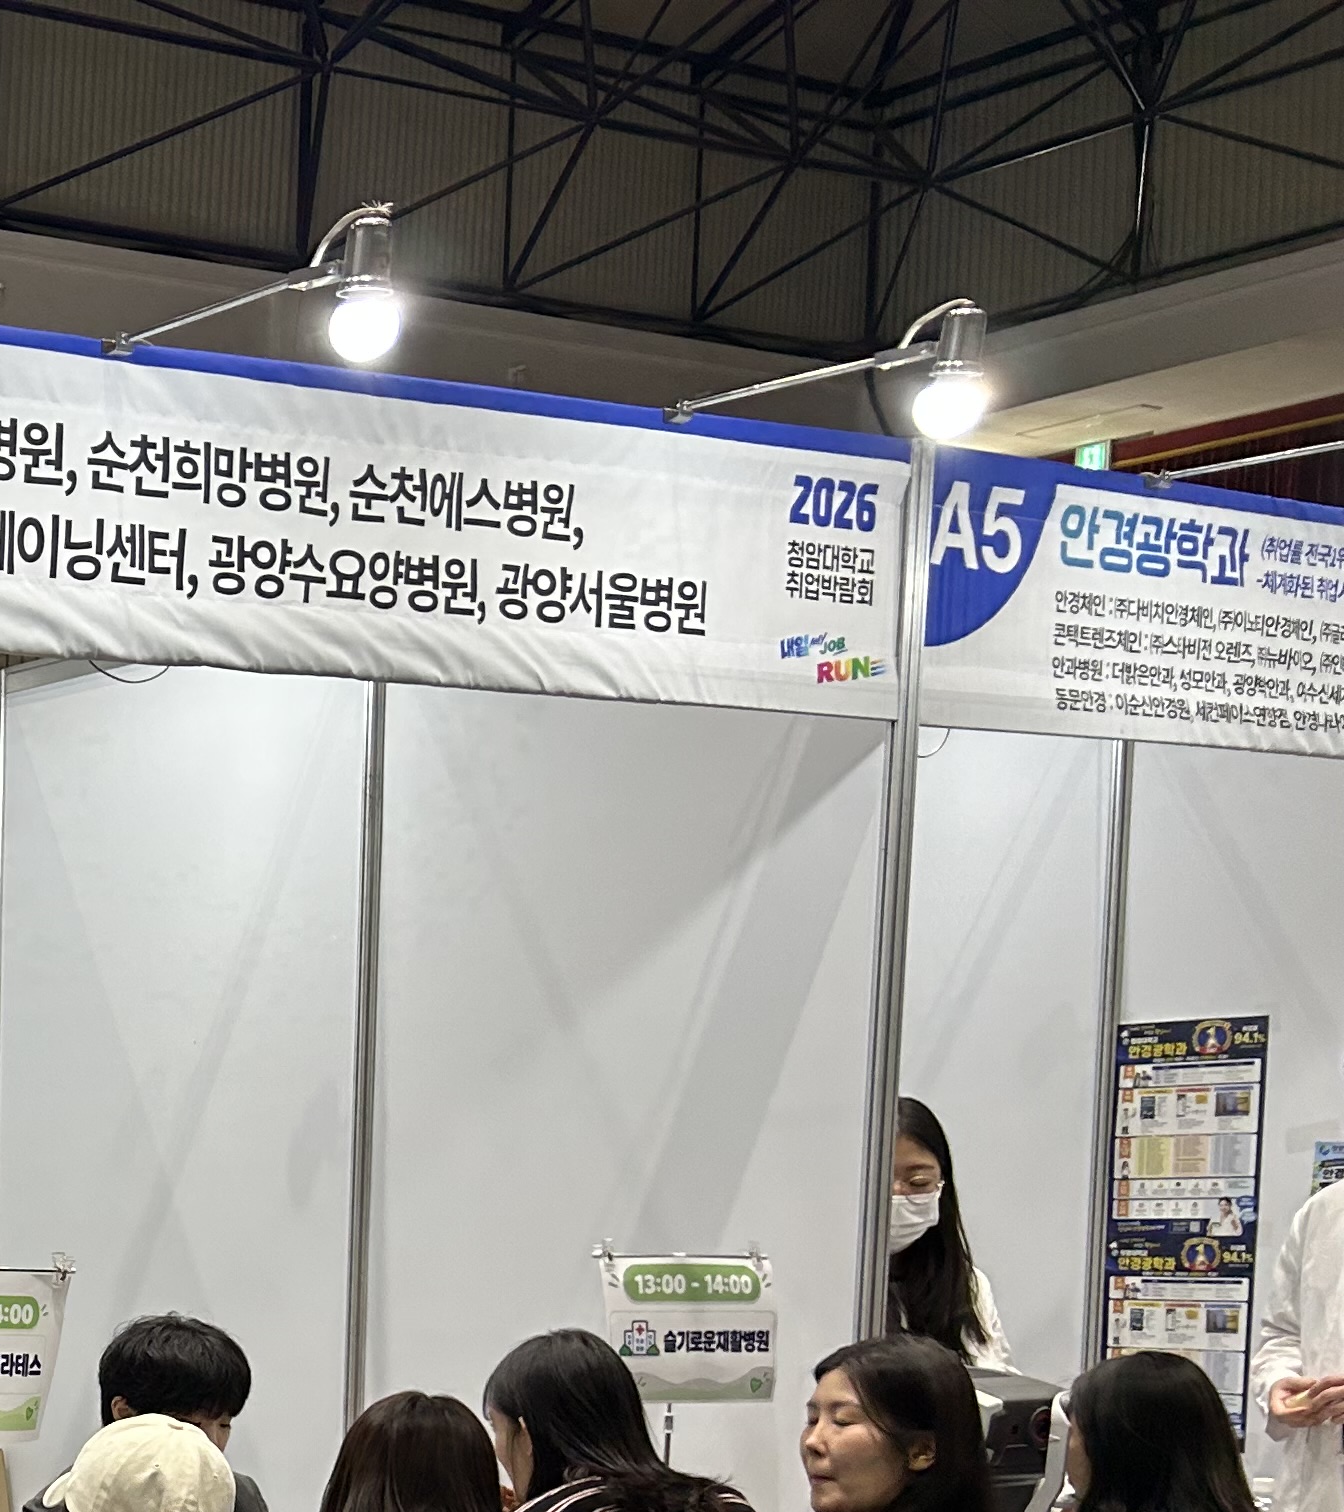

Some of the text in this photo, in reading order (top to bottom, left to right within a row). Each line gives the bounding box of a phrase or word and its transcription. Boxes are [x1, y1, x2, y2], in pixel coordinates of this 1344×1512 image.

[86, 430, 341, 528] 순천희망병원,
[348, 461, 585, 549] 순천에스병원,
[788, 474, 880, 533] 2026
[930, 480, 1027, 574] A5
[1060, 504, 1251, 588] 안경광학과
[787, 540, 875, 574] 청암대학교
[207, 532, 487, 625] 광양수요양병원,
[495, 561, 708, 637] 광양서울병원
[785, 570, 874, 606] 취업박람회
[816, 655, 870, 684] RUN
[634, 1274, 686, 1294] 13:00
[704, 1274, 753, 1295] 14:00
[663, 1330, 771, 1353] 슬기로운재활병원
